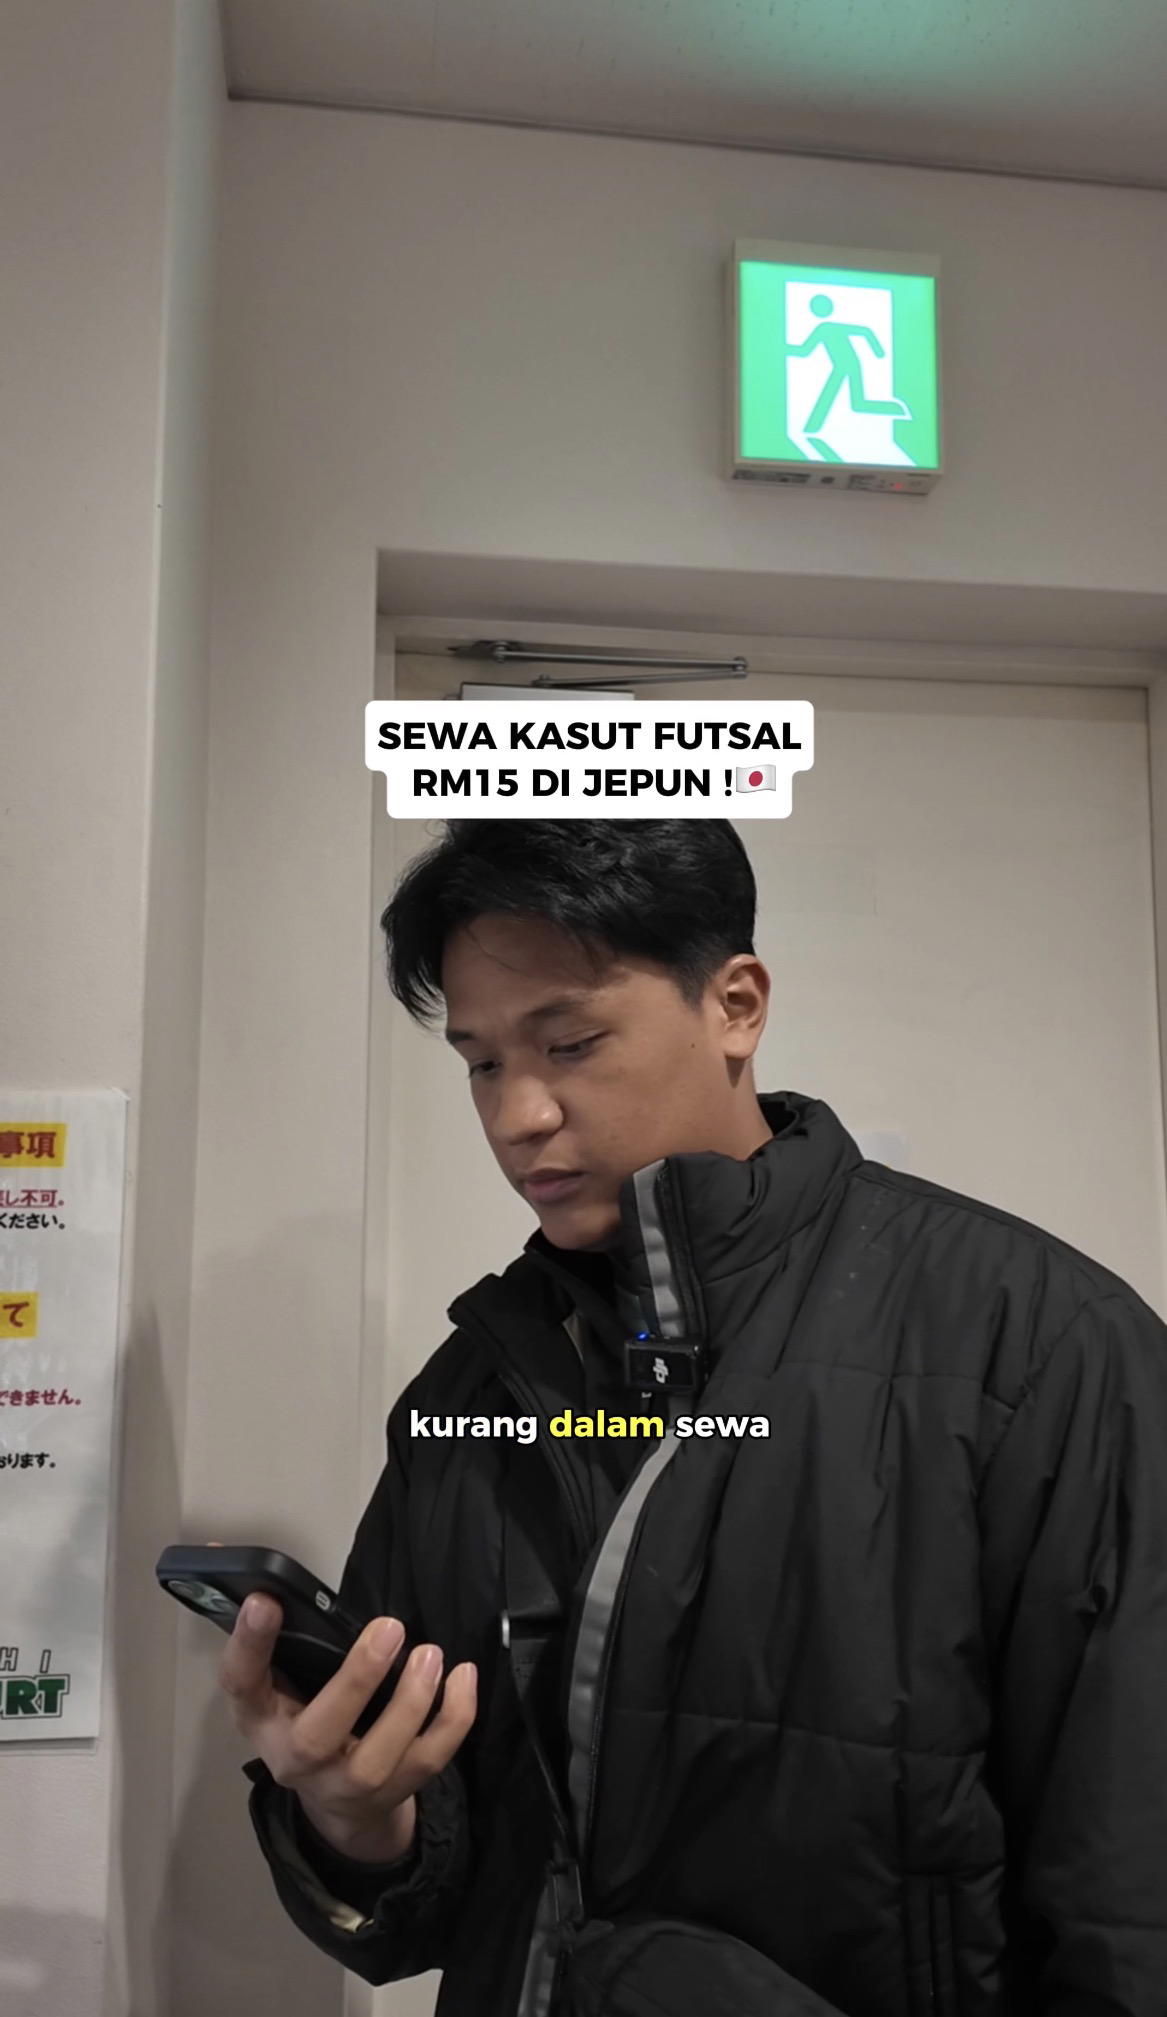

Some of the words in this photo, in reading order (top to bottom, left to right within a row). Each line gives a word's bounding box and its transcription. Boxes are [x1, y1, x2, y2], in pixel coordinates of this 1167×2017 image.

[0, 1131, 57, 1159] 事項
[2, 1301, 30, 1328] て
[0, 1674, 70, 1719] RT
